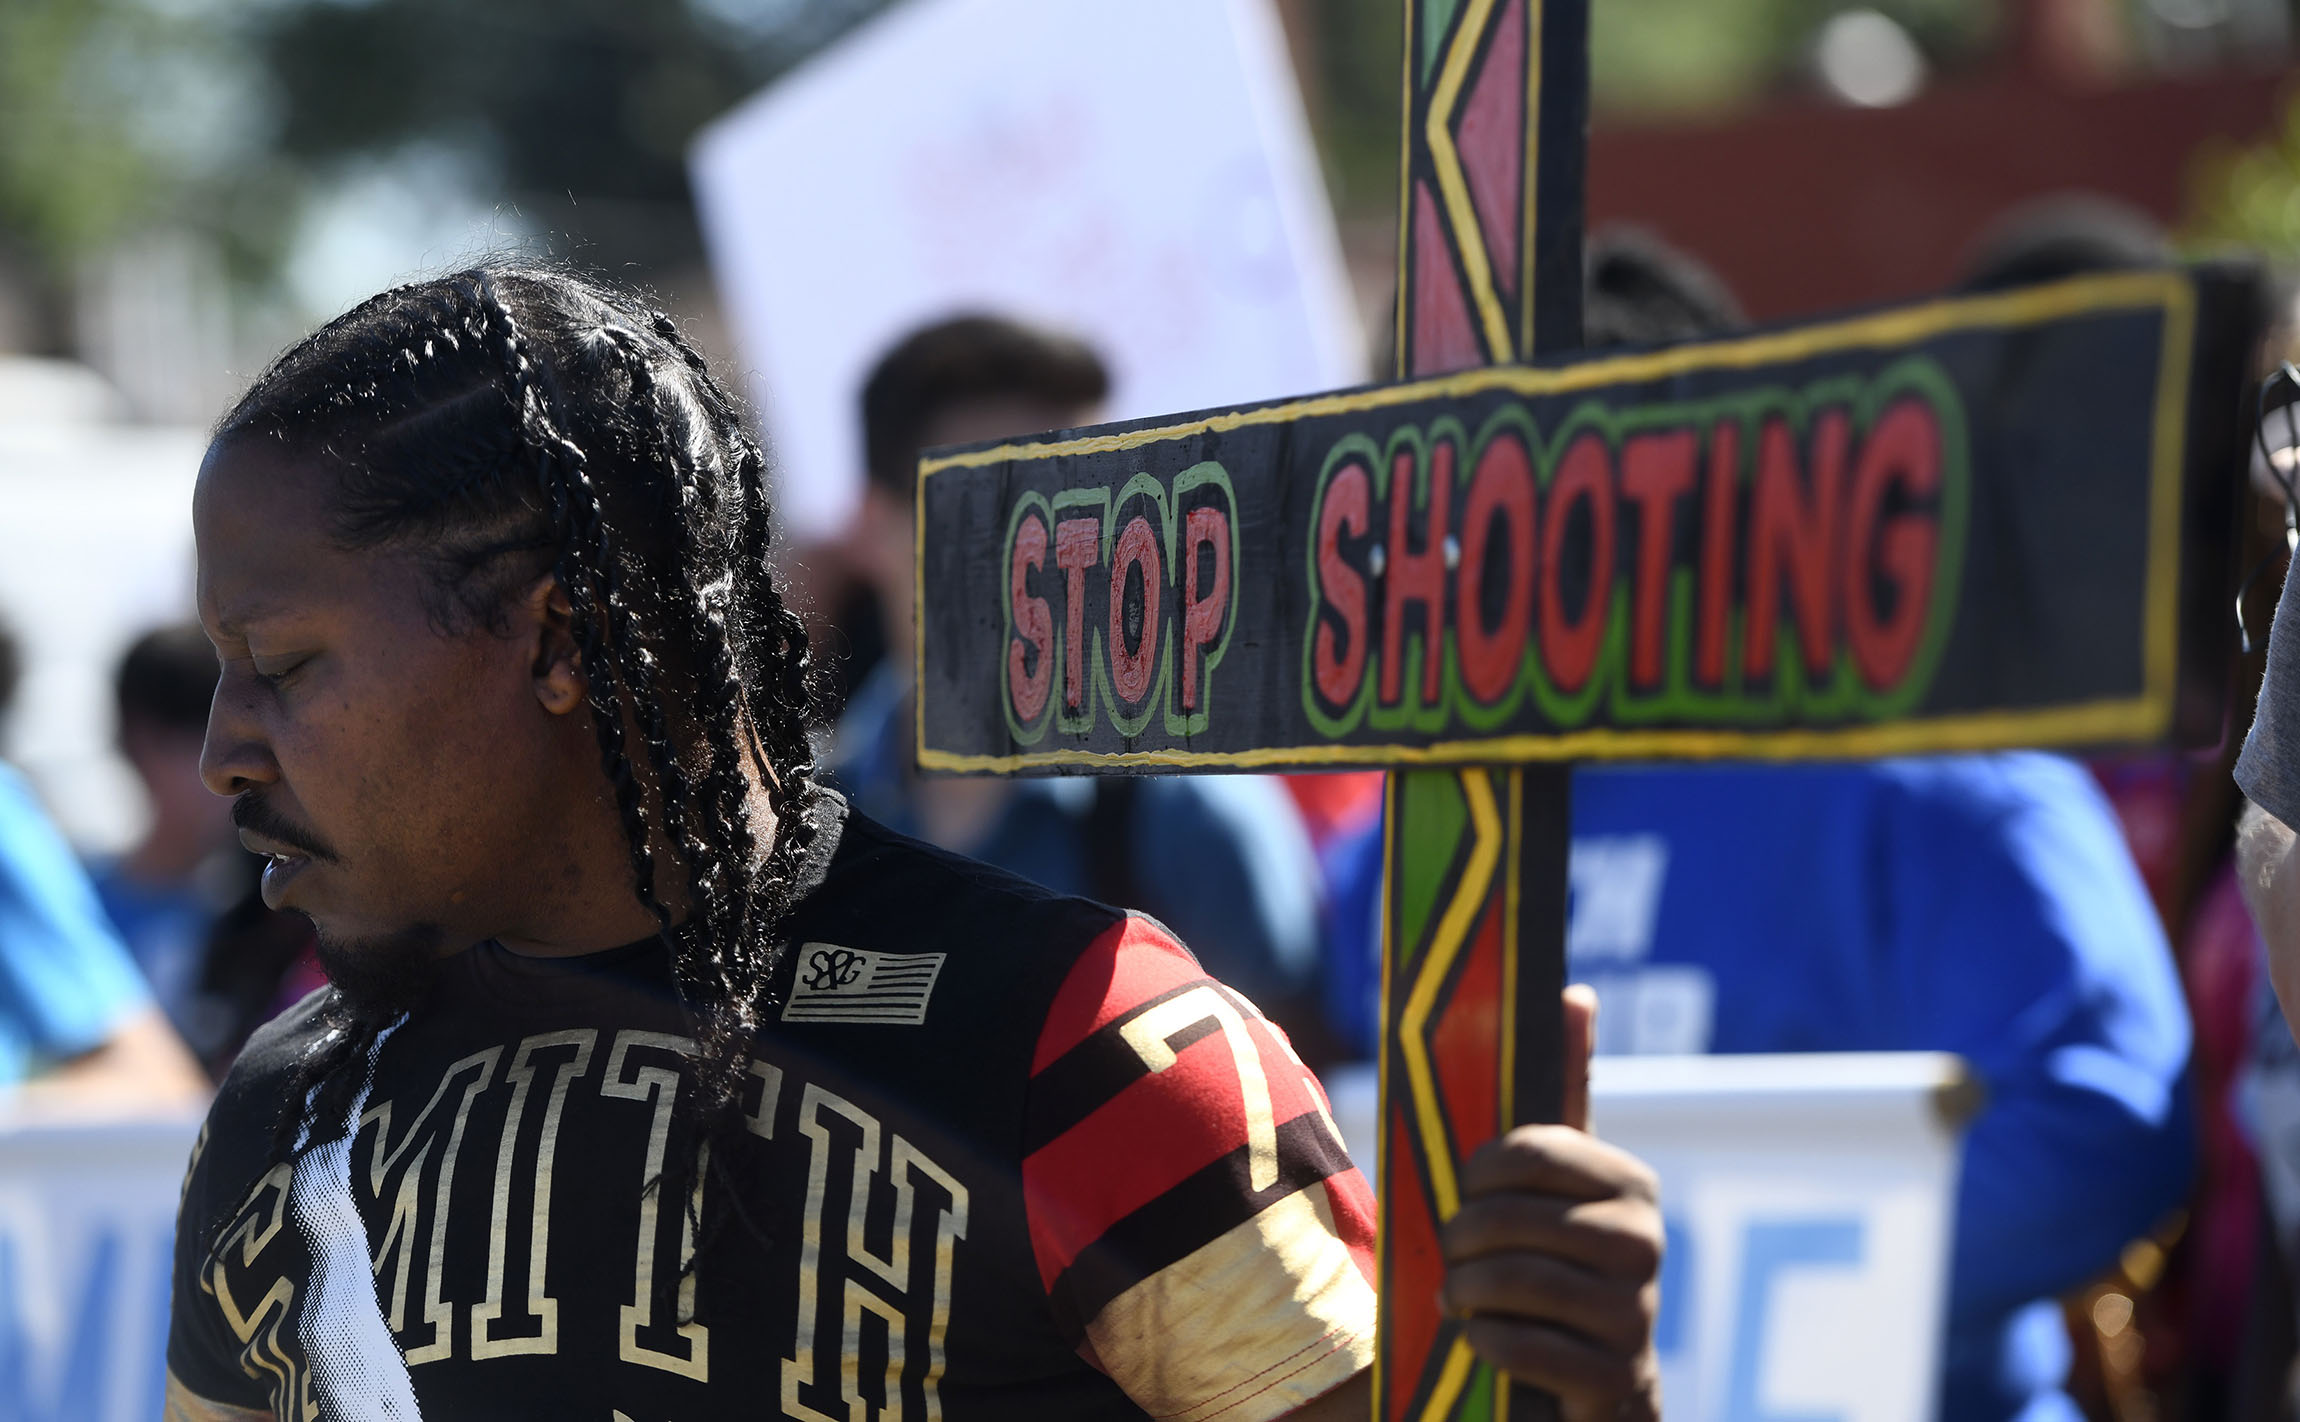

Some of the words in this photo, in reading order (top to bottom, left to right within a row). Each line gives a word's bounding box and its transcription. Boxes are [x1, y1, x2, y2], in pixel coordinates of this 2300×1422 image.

[1007, 502, 1233, 724] STOP
[1313, 396, 1943, 707] SHOOTING
[802, 949, 867, 991] S&G
